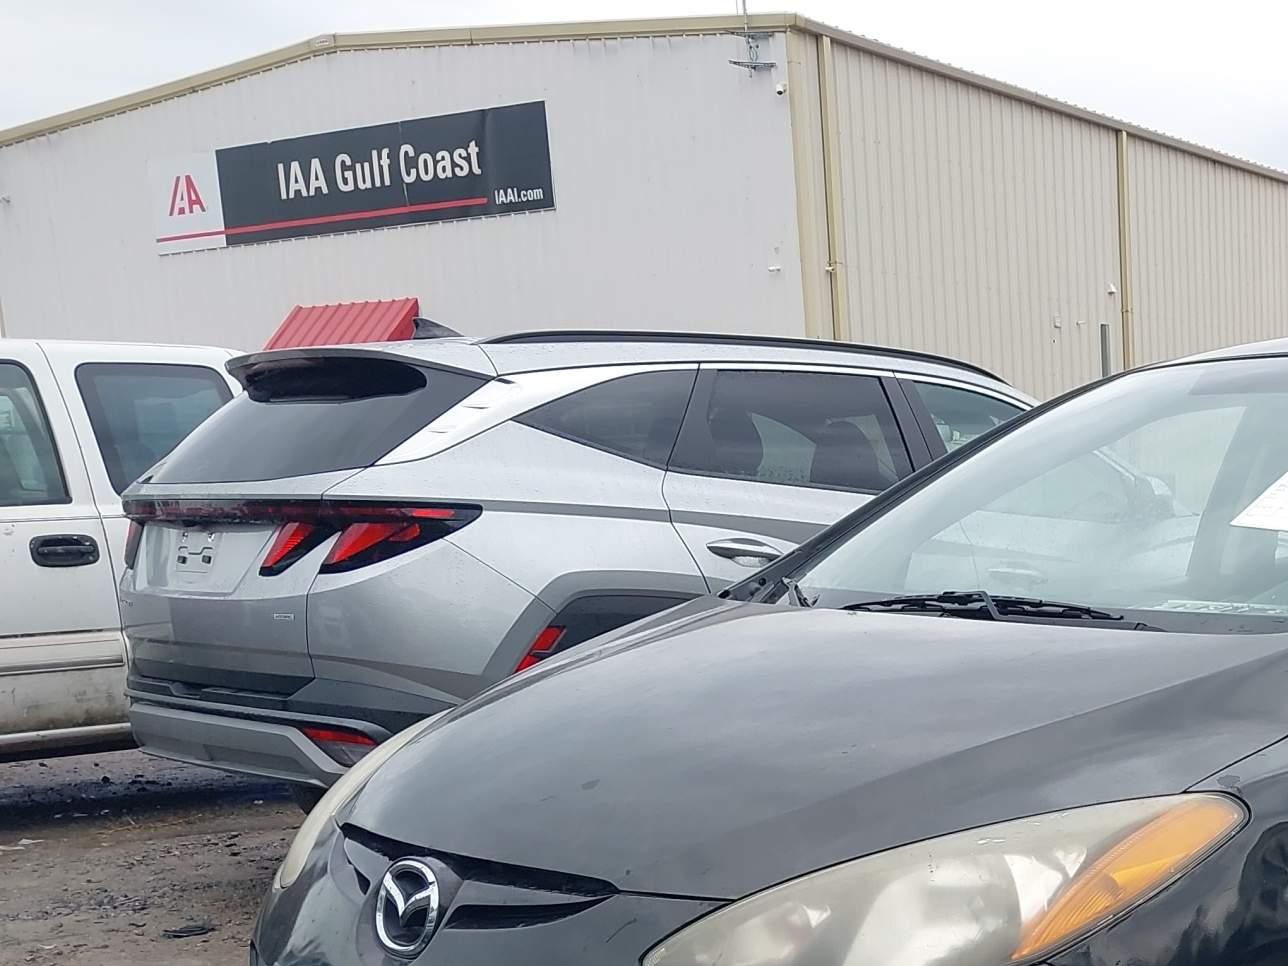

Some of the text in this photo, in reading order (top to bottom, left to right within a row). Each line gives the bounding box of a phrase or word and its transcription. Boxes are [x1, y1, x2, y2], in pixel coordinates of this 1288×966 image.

[277, 140, 482, 200] IAA Gulf Coast
[494, 187, 544, 205] IAAI.com
